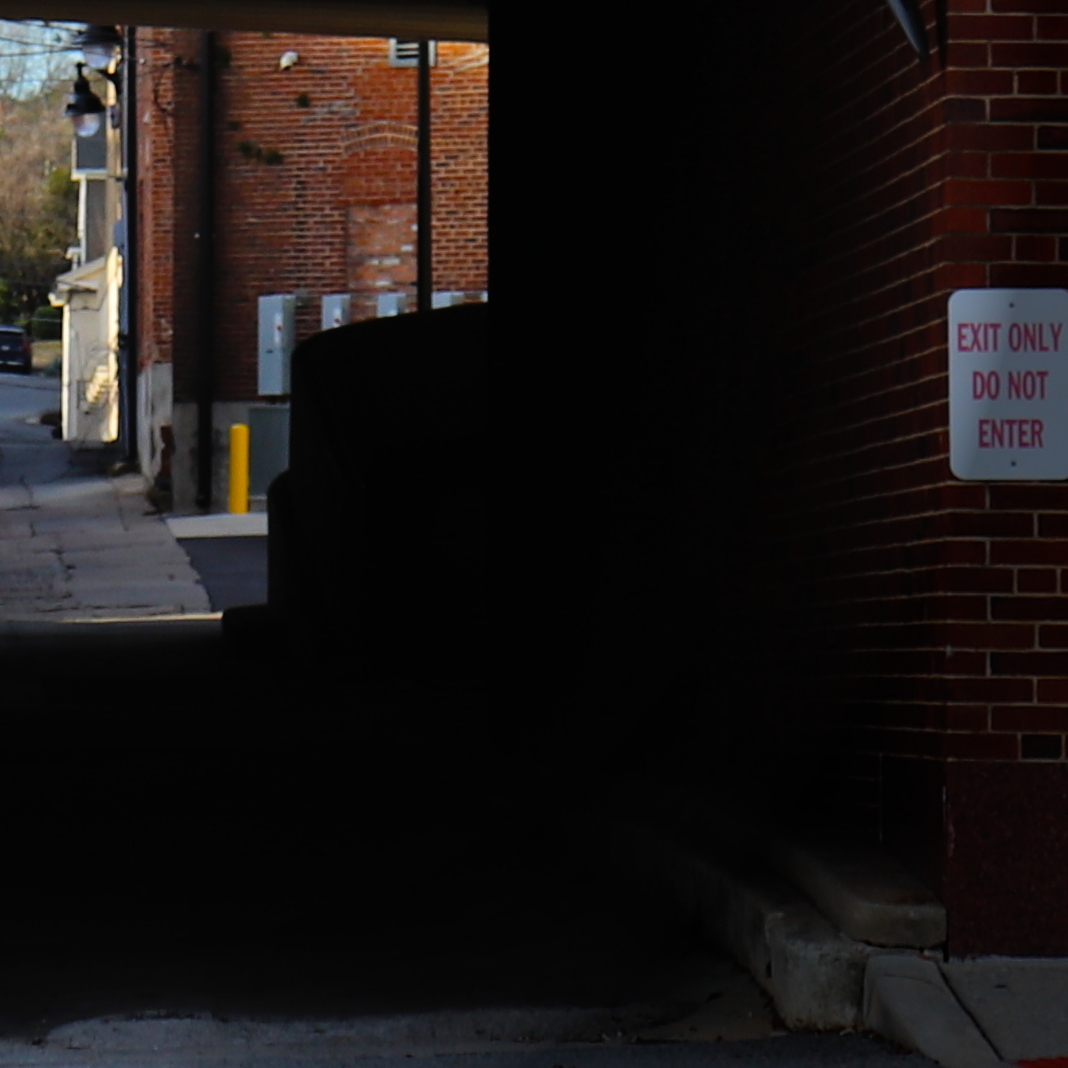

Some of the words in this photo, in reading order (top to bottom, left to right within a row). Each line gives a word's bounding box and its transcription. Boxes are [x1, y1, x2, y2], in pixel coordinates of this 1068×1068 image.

[957, 323, 1002, 352] EXIT
[1007, 323, 1063, 352] ONLY
[972, 371, 1001, 400] DO
[1007, 371, 1049, 400] NOT
[978, 419, 1045, 448] ENTER
